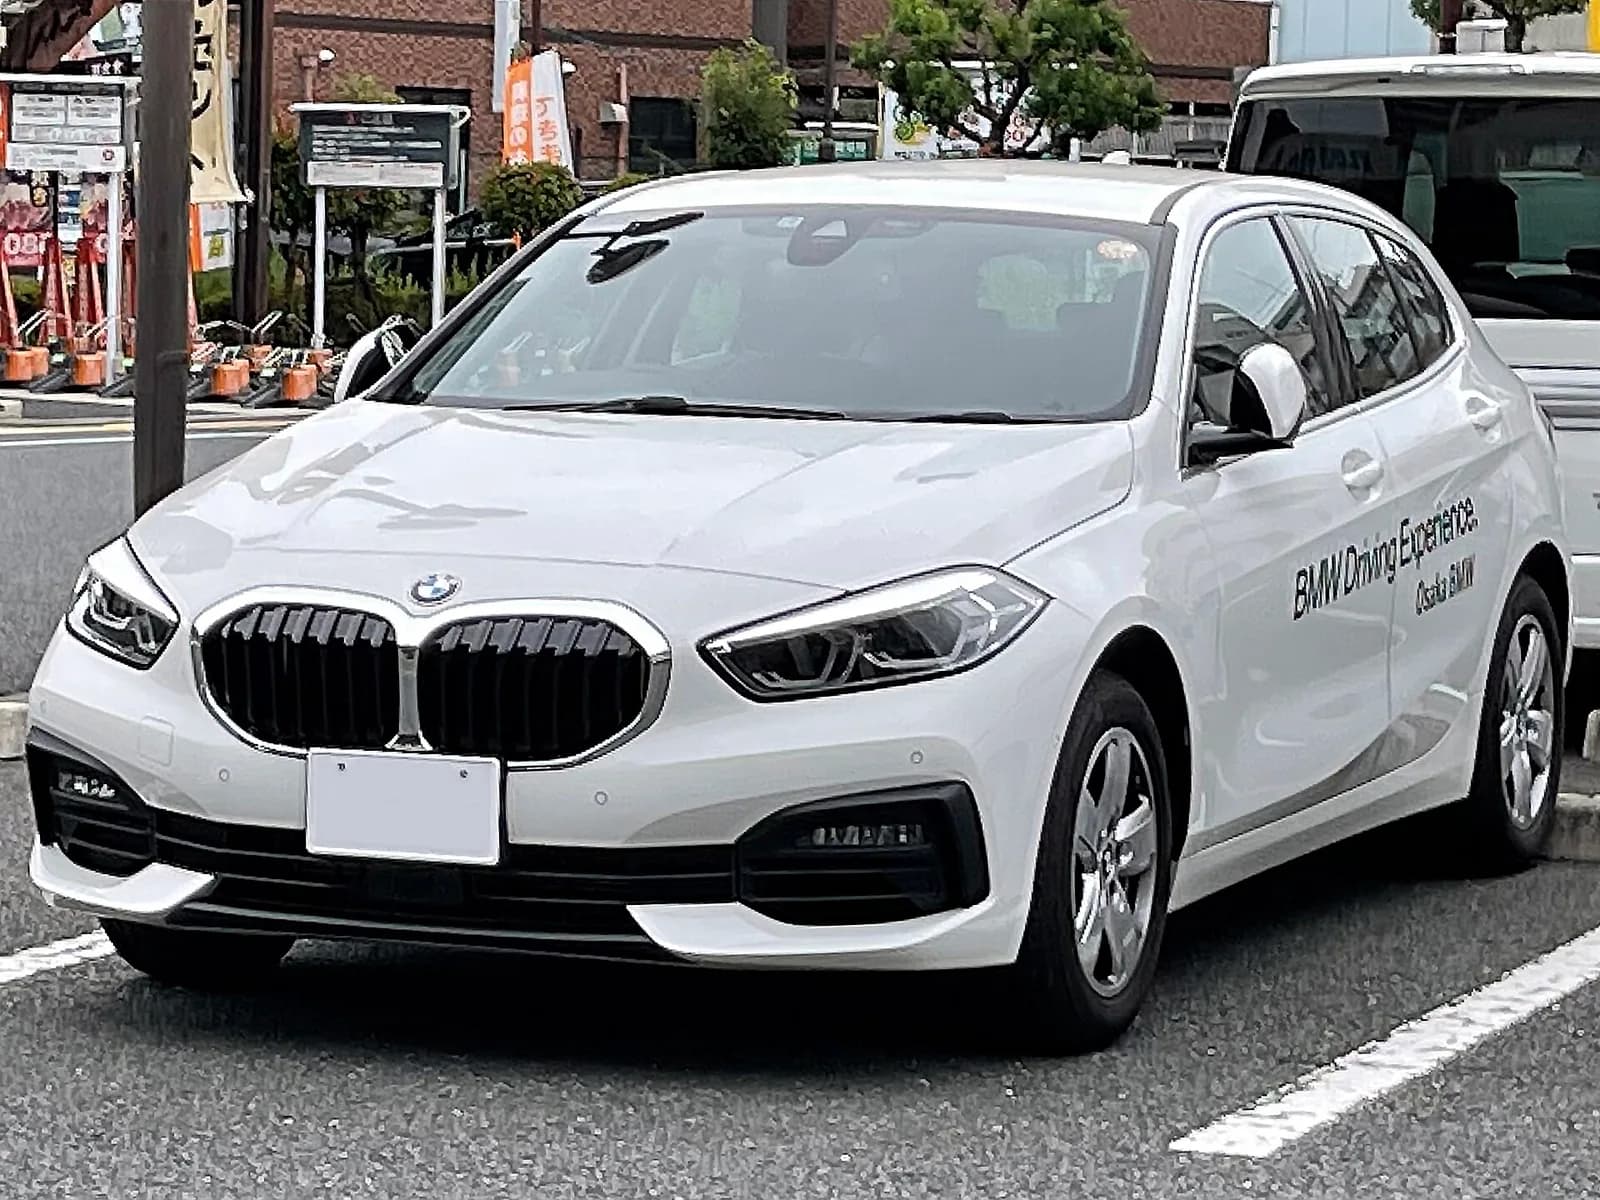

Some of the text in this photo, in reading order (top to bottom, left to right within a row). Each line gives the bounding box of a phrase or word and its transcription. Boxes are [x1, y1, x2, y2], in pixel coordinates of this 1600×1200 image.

[1293, 497, 1478, 621] BMW Driving Experience.
